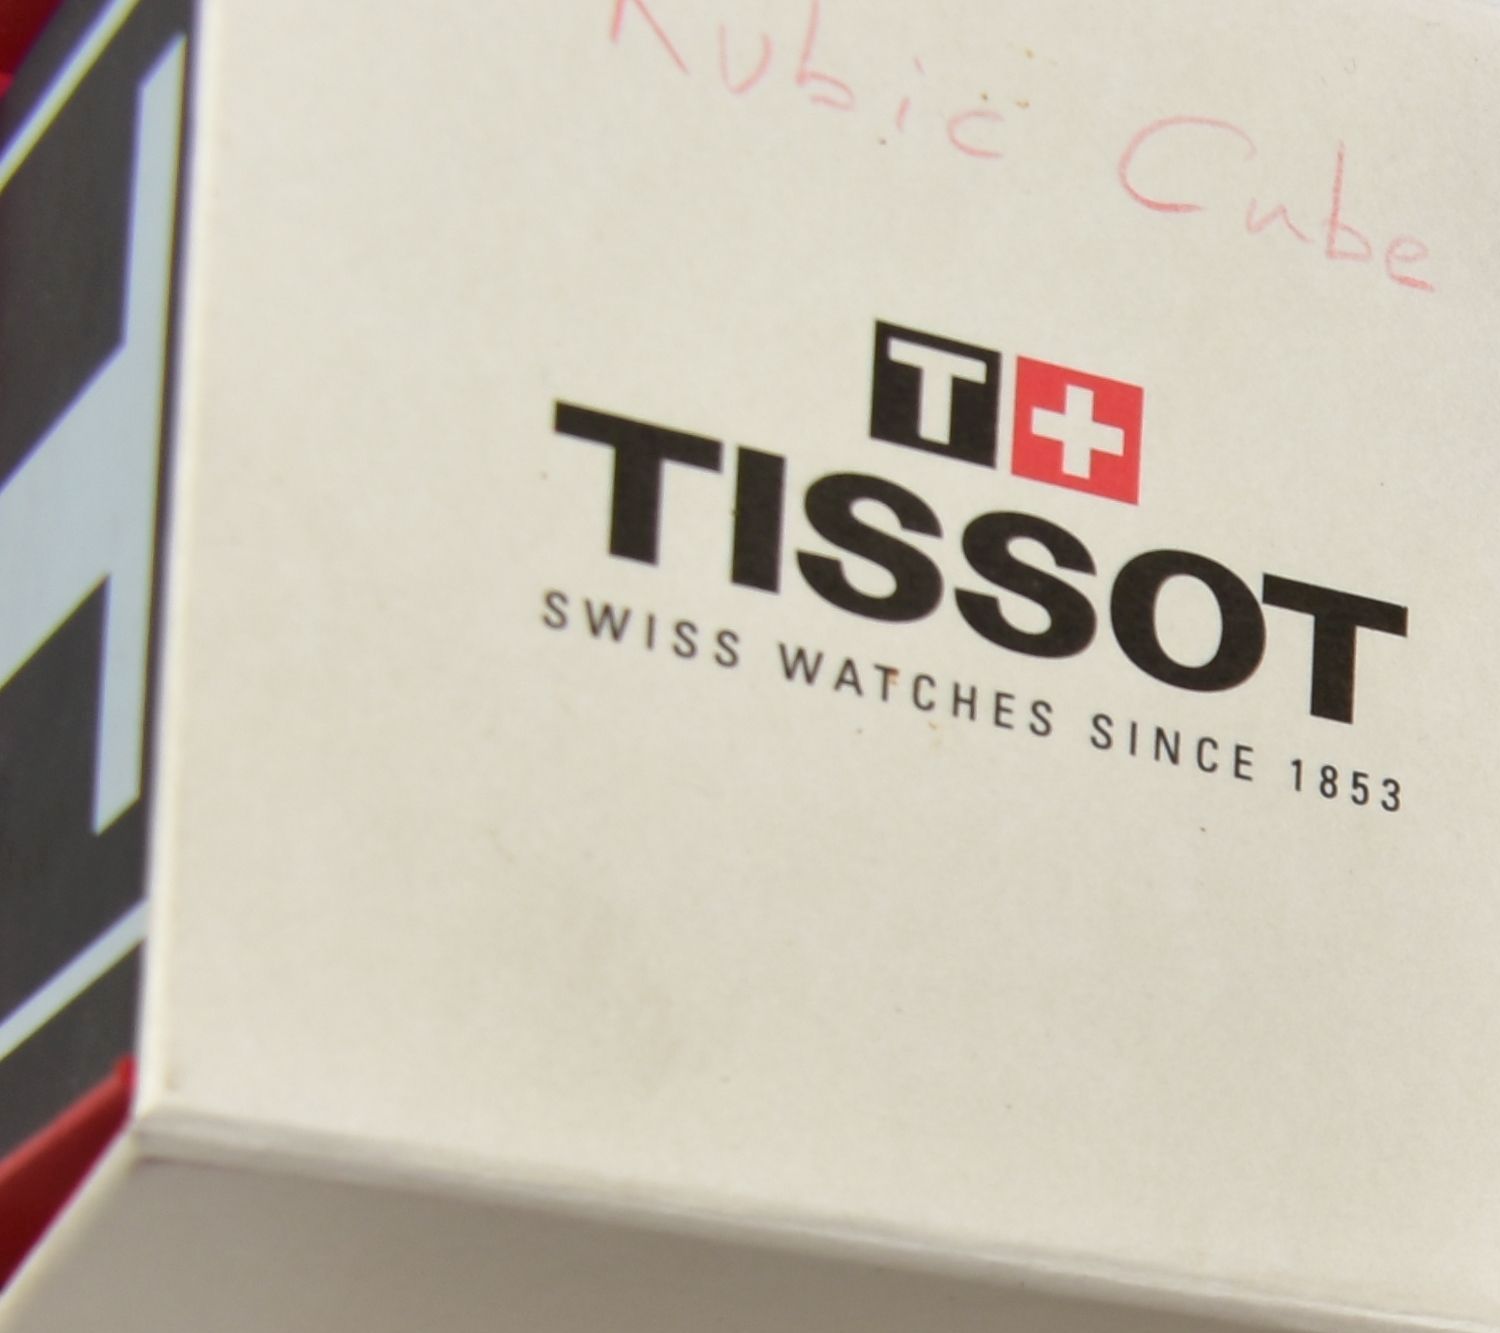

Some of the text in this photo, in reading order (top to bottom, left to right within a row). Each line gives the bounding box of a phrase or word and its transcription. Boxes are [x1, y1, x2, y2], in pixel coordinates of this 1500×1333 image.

[1116, 115, 1436, 293] Cube
[552, 400, 1410, 726] TISSOT
[540, 590, 1404, 815] SWISS WATCHES SINCE 1853
